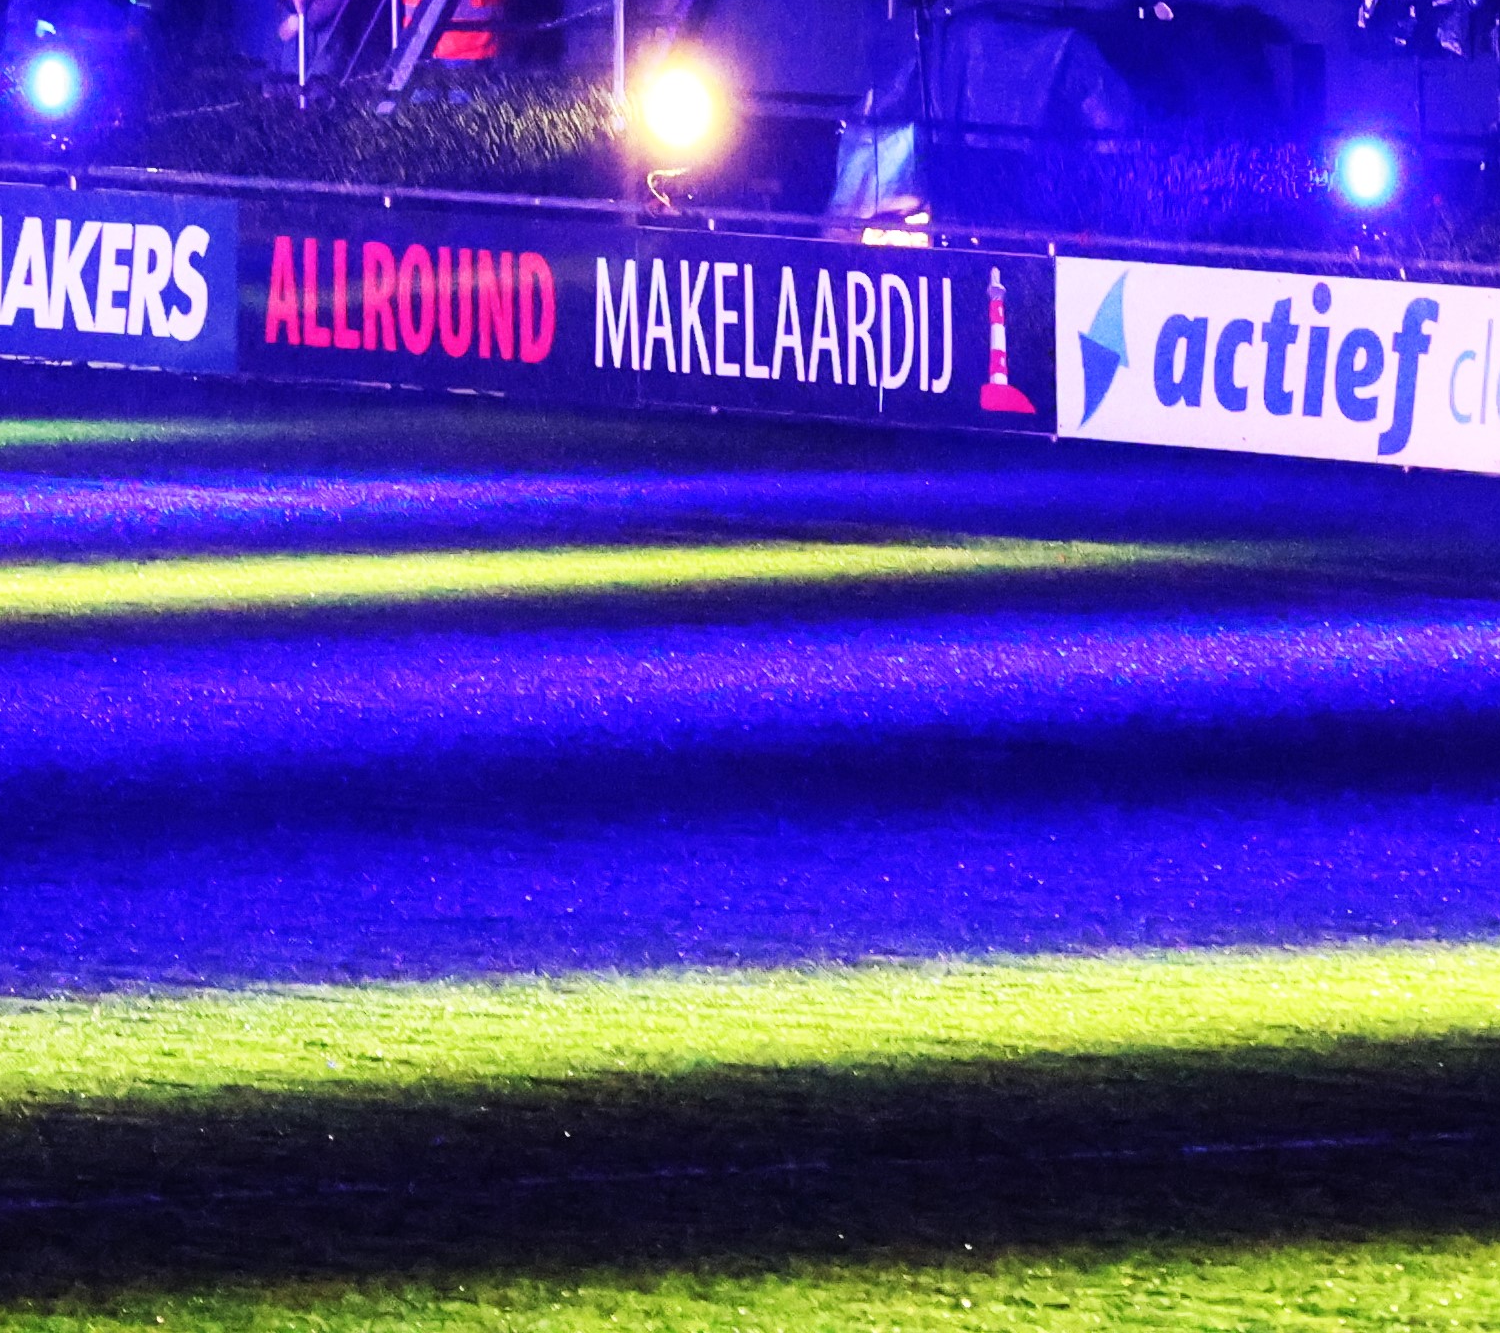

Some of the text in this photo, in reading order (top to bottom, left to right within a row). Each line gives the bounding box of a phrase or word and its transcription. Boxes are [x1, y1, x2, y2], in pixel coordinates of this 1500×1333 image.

[265, 235, 952, 394] ALLROUND MAKELAARDIJ
[1153, 282, 1440, 456] actief
